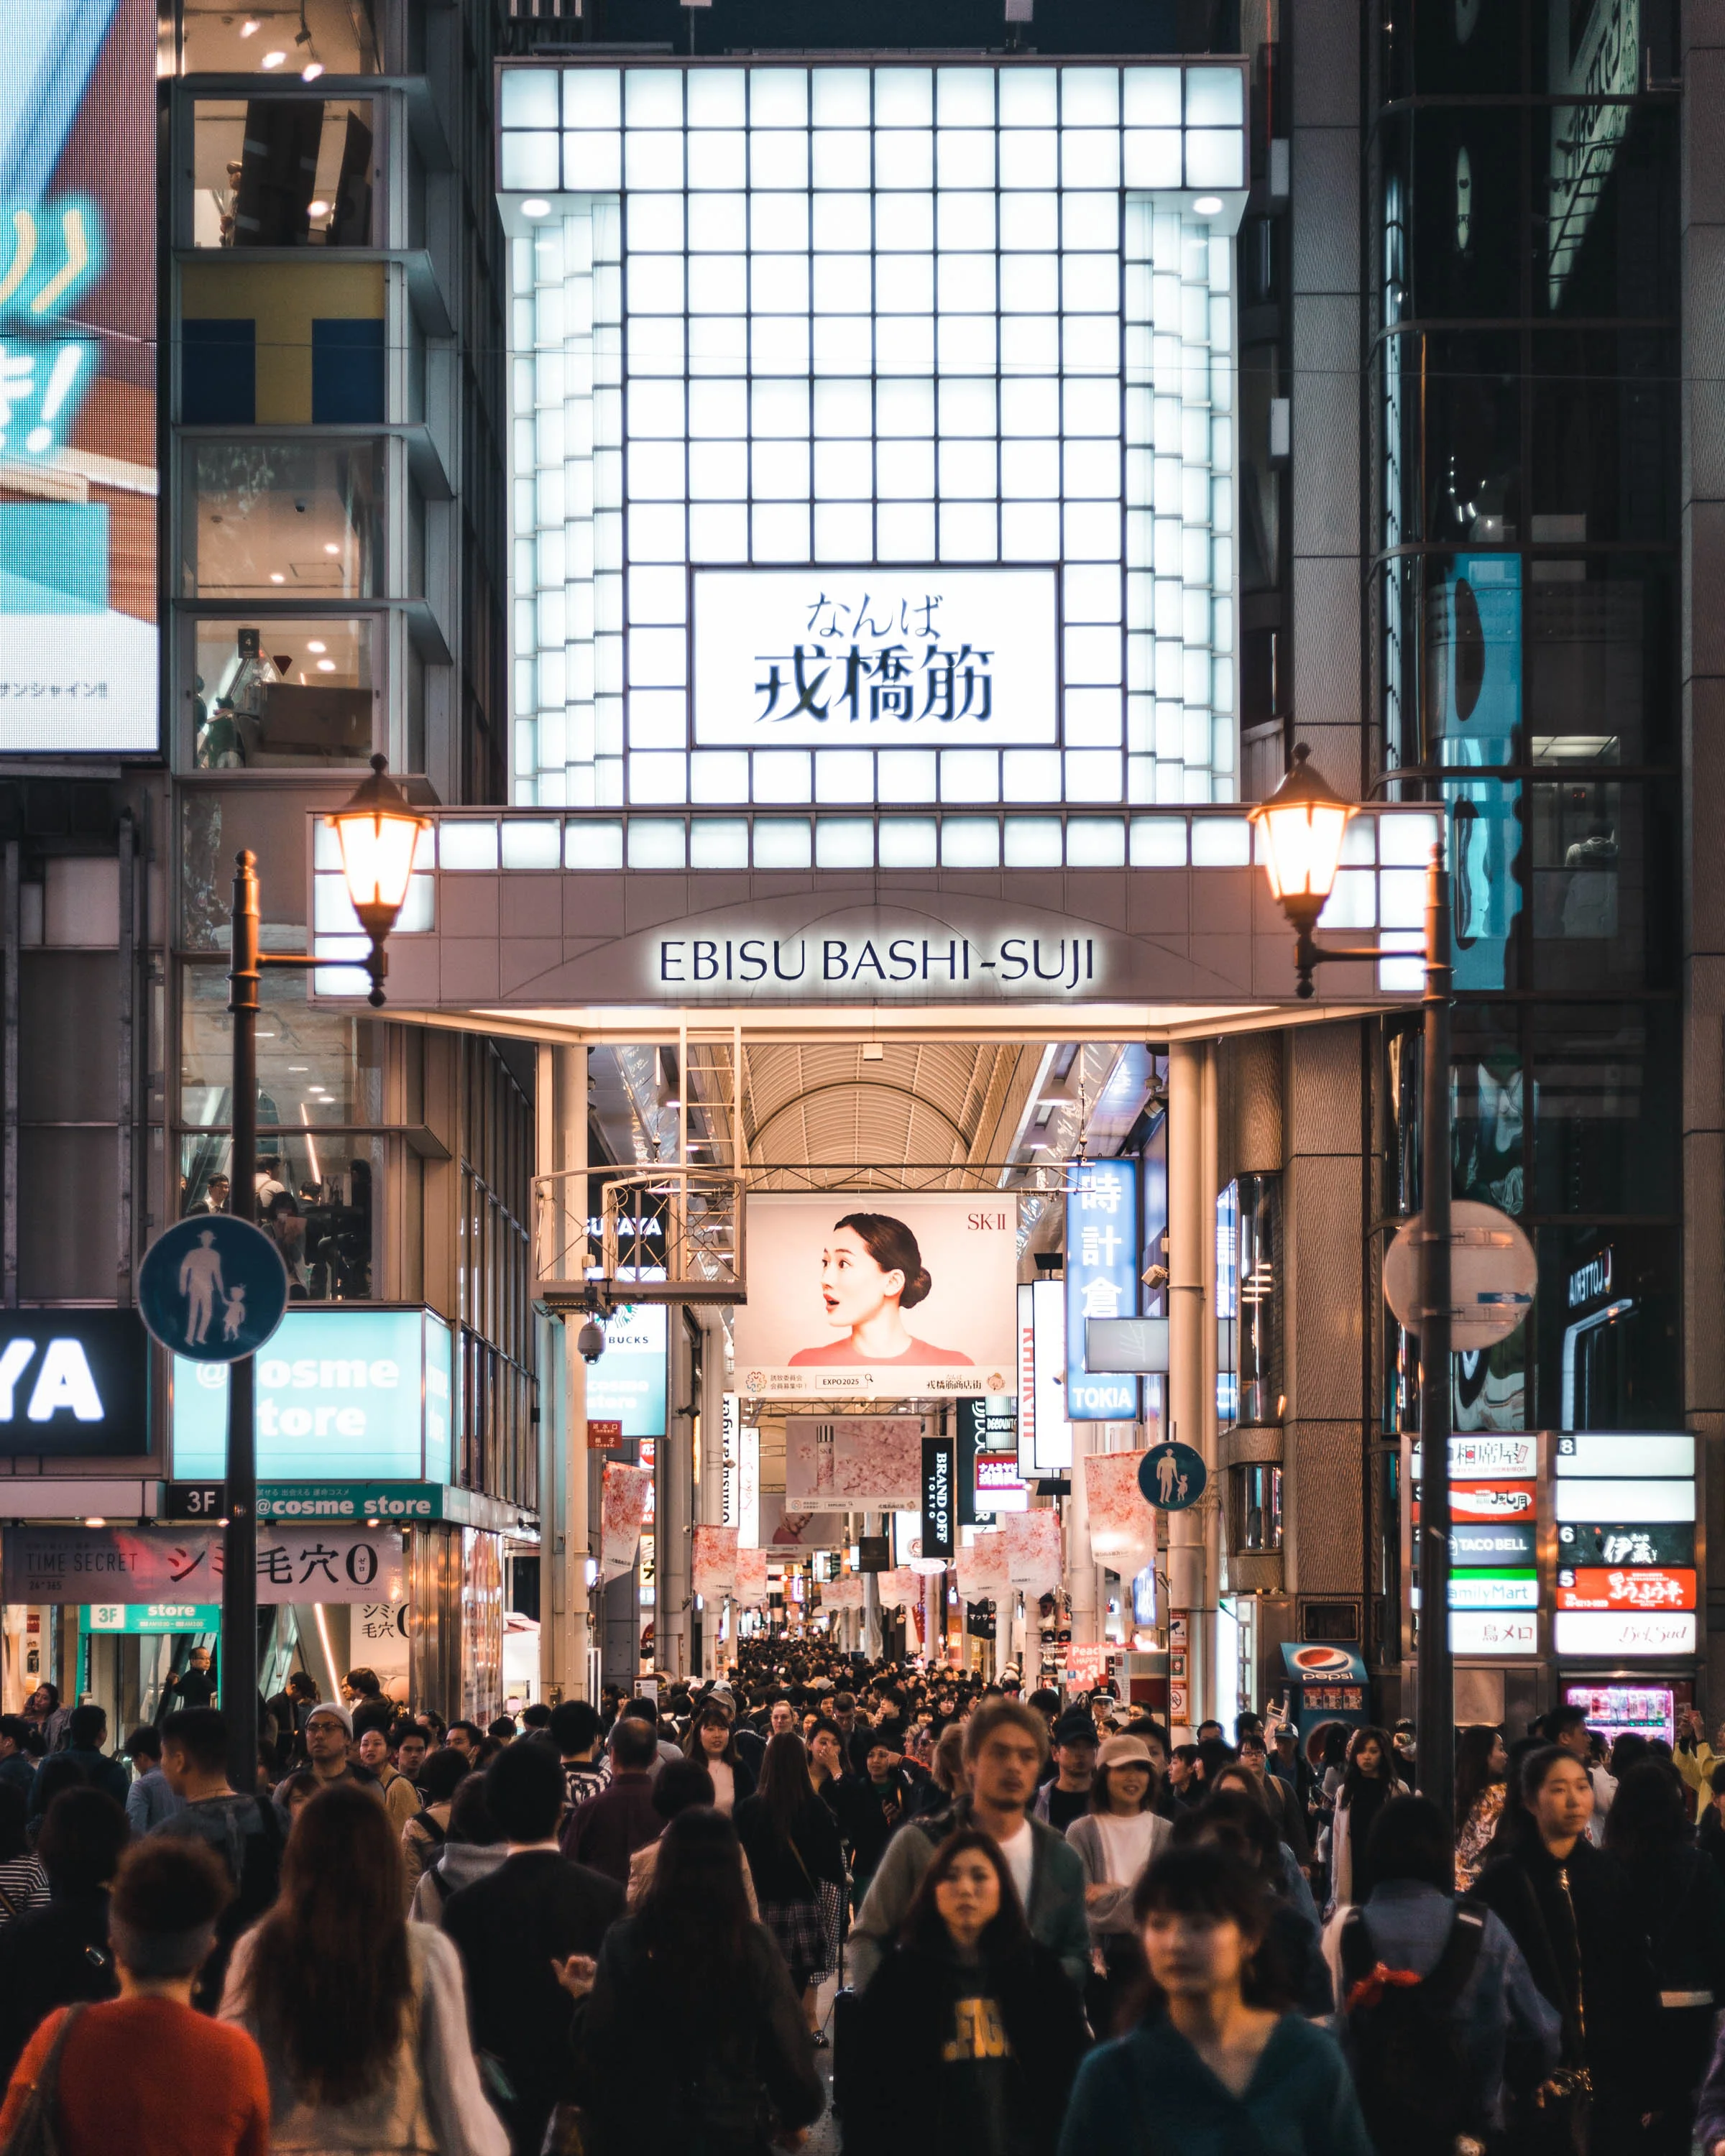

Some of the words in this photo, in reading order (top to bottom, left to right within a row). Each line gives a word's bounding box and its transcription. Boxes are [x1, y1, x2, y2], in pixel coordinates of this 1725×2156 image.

[806, 591, 943, 640] なんば
[753, 644, 995, 723] 戎橋筋
[661, 940, 804, 981] EBISU
[823, 939, 1093, 990] BASHI-SUJI
[586, 1217, 662, 1235] UAYA
[967, 1213, 1006, 1230] SK-II
[1081, 1174, 1122, 1376] 時計倉
[196, 1358, 400, 1389] @osme
[1072, 1387, 1133, 1408] TOKIA
[256, 1398, 367, 1436] tore
[1560, 1439, 1573, 1454] 8
[937, 1452, 947, 1508] BRAND
[187, 1491, 215, 1513] 3F
[256, 1498, 354, 1515] @cosme
[364, 1495, 431, 1515] store
[937, 1511, 947, 1543] OFF
[1560, 1526, 1575, 1544] 6
[1460, 1539, 1494, 1551] TACO
[1495, 1539, 1527, 1551] BELL
[27, 1553, 65, 1572] TIME
[73, 1552, 138, 1572] SECRET
[1560, 1570, 1575, 1588] 5
[1448, 1585, 1529, 1603] amilyMart
[98, 1608, 117, 1623] 3F
[148, 1604, 196, 1616] store
[362, 1622, 395, 1638] 毛穴
[1302, 1672, 1353, 1681] pepsi
